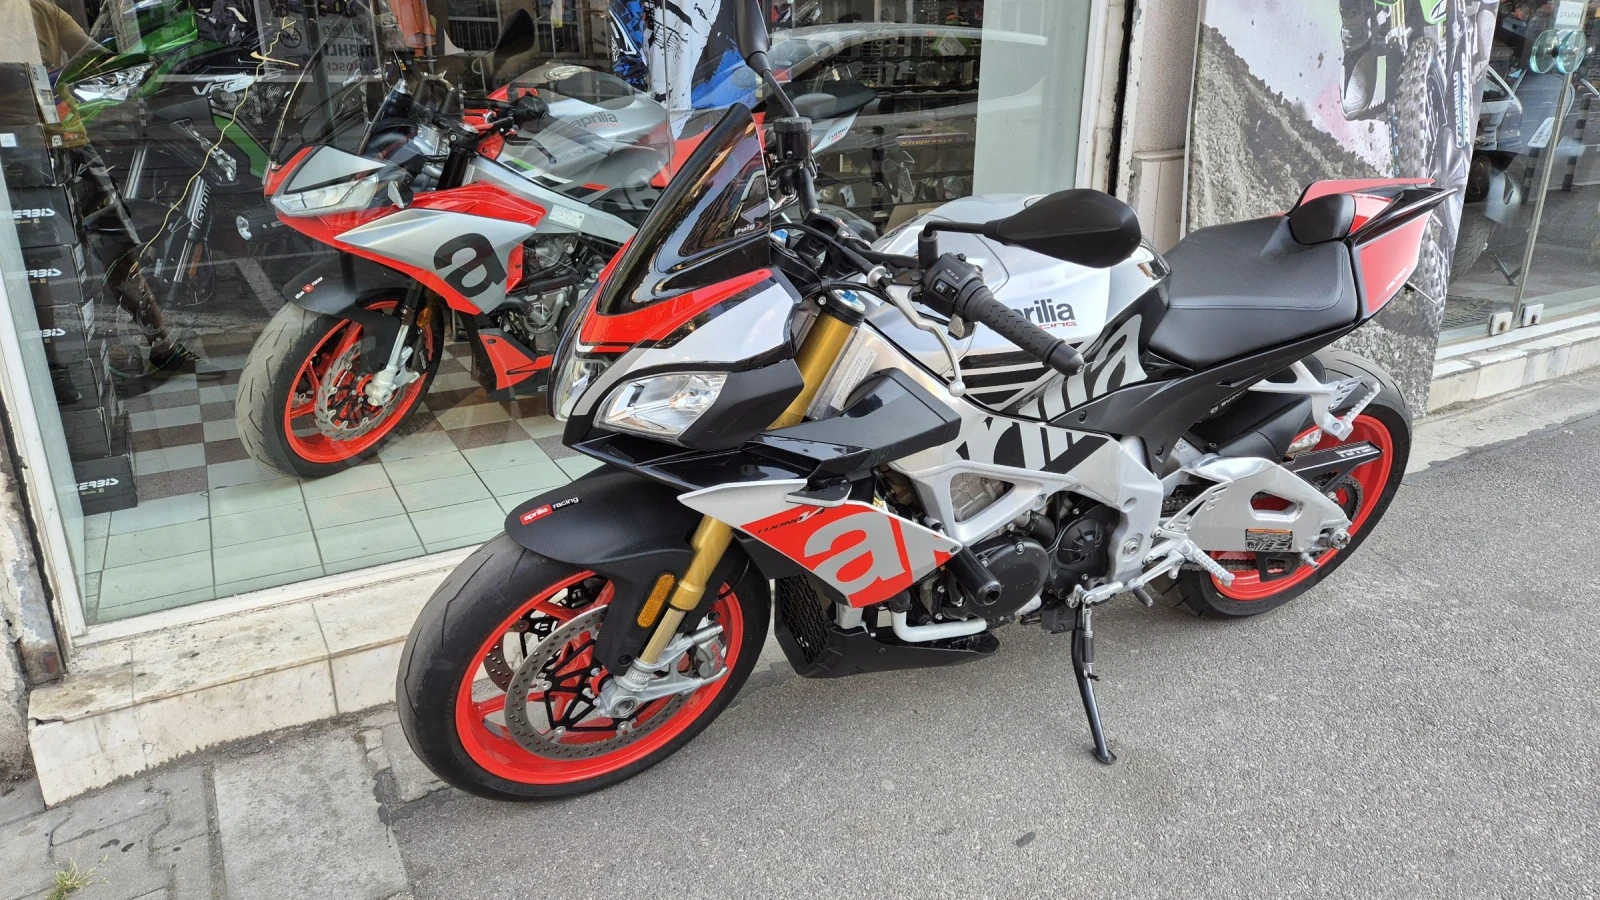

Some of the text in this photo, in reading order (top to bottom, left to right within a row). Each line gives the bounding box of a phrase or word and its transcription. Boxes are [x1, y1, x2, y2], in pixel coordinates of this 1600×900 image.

[571, 111, 619, 129] aprilia
[12, 208, 56, 219] ERBIS
[76, 477, 119, 490] ERBIS
[523, 496, 579, 521] aprilia racing
